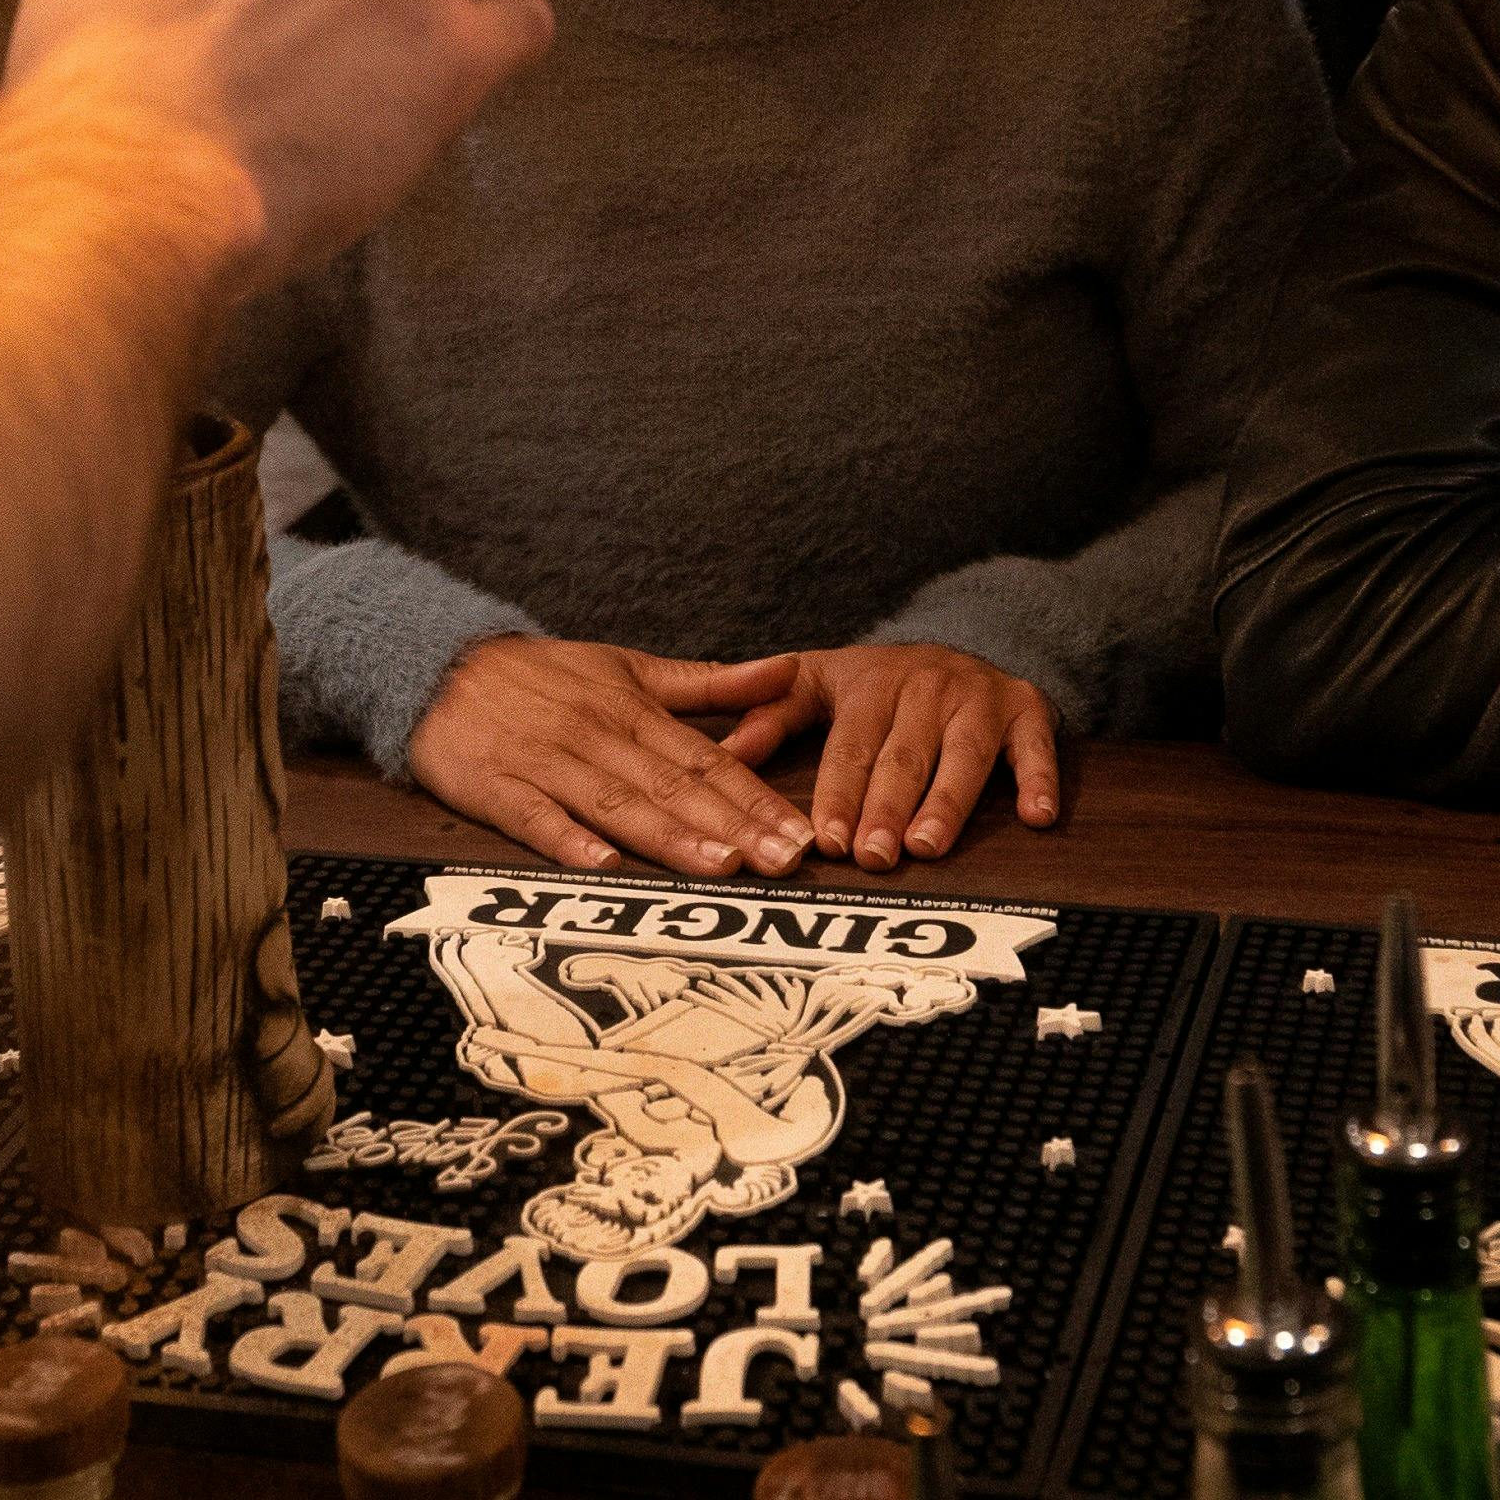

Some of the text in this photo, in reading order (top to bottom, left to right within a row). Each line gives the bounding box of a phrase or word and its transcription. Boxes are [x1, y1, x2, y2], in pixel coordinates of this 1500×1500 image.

[865, 895, 908, 907] DRINK
[994, 904, 1059, 917] RESPECT
[467, 886, 978, 960] GINGER
[204, 1194, 825, 1330] LOVES
